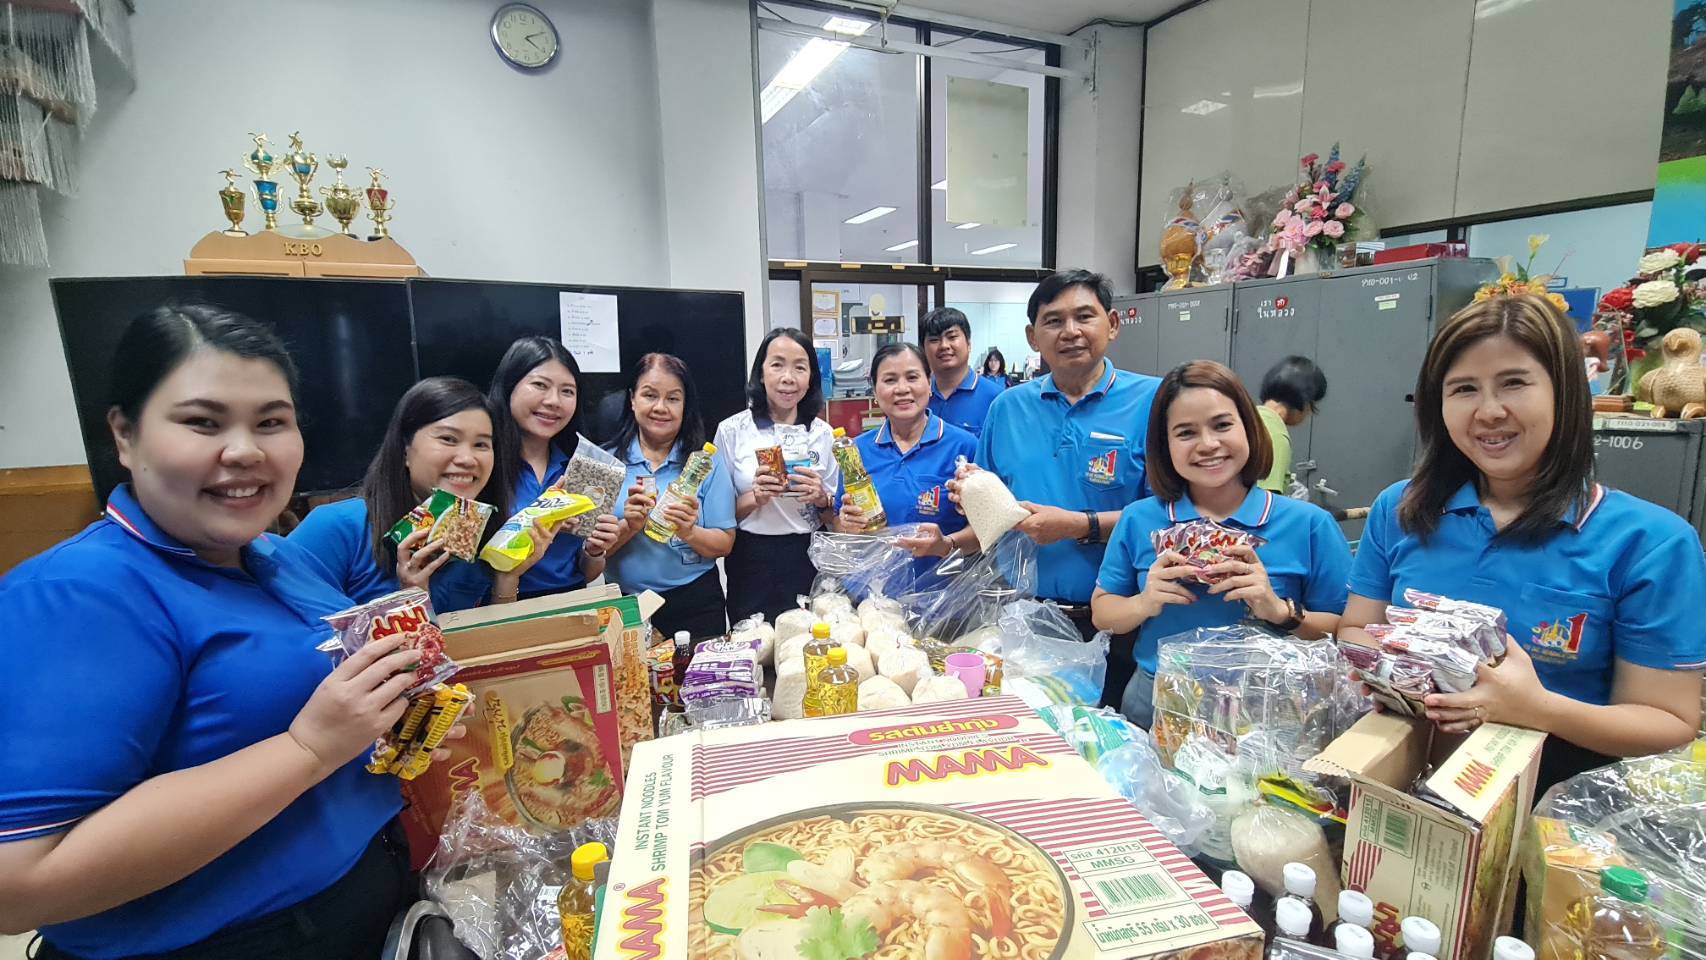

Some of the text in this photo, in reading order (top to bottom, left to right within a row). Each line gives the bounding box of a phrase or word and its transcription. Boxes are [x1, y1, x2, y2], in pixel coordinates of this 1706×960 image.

[283, 242, 323, 257] KBO
[1120, 316, 1143, 326] นหลวง
[1257, 308, 1296, 320] ในหลวง
[1566, 612, 1589, 654] 1
[887, 745, 1049, 786] MAMA
[1454, 758, 1497, 798] MAMA
[634, 771, 657, 850] INSTANT NOODLES
[651, 753, 674, 872] SHRIMP TOM YUM FLAVOUR
[1096, 843, 1141, 856] 412015
[1090, 855, 1136, 869] MMSG
[1135, 921, 1153, 936] 55
[1174, 914, 1192, 929] 30
